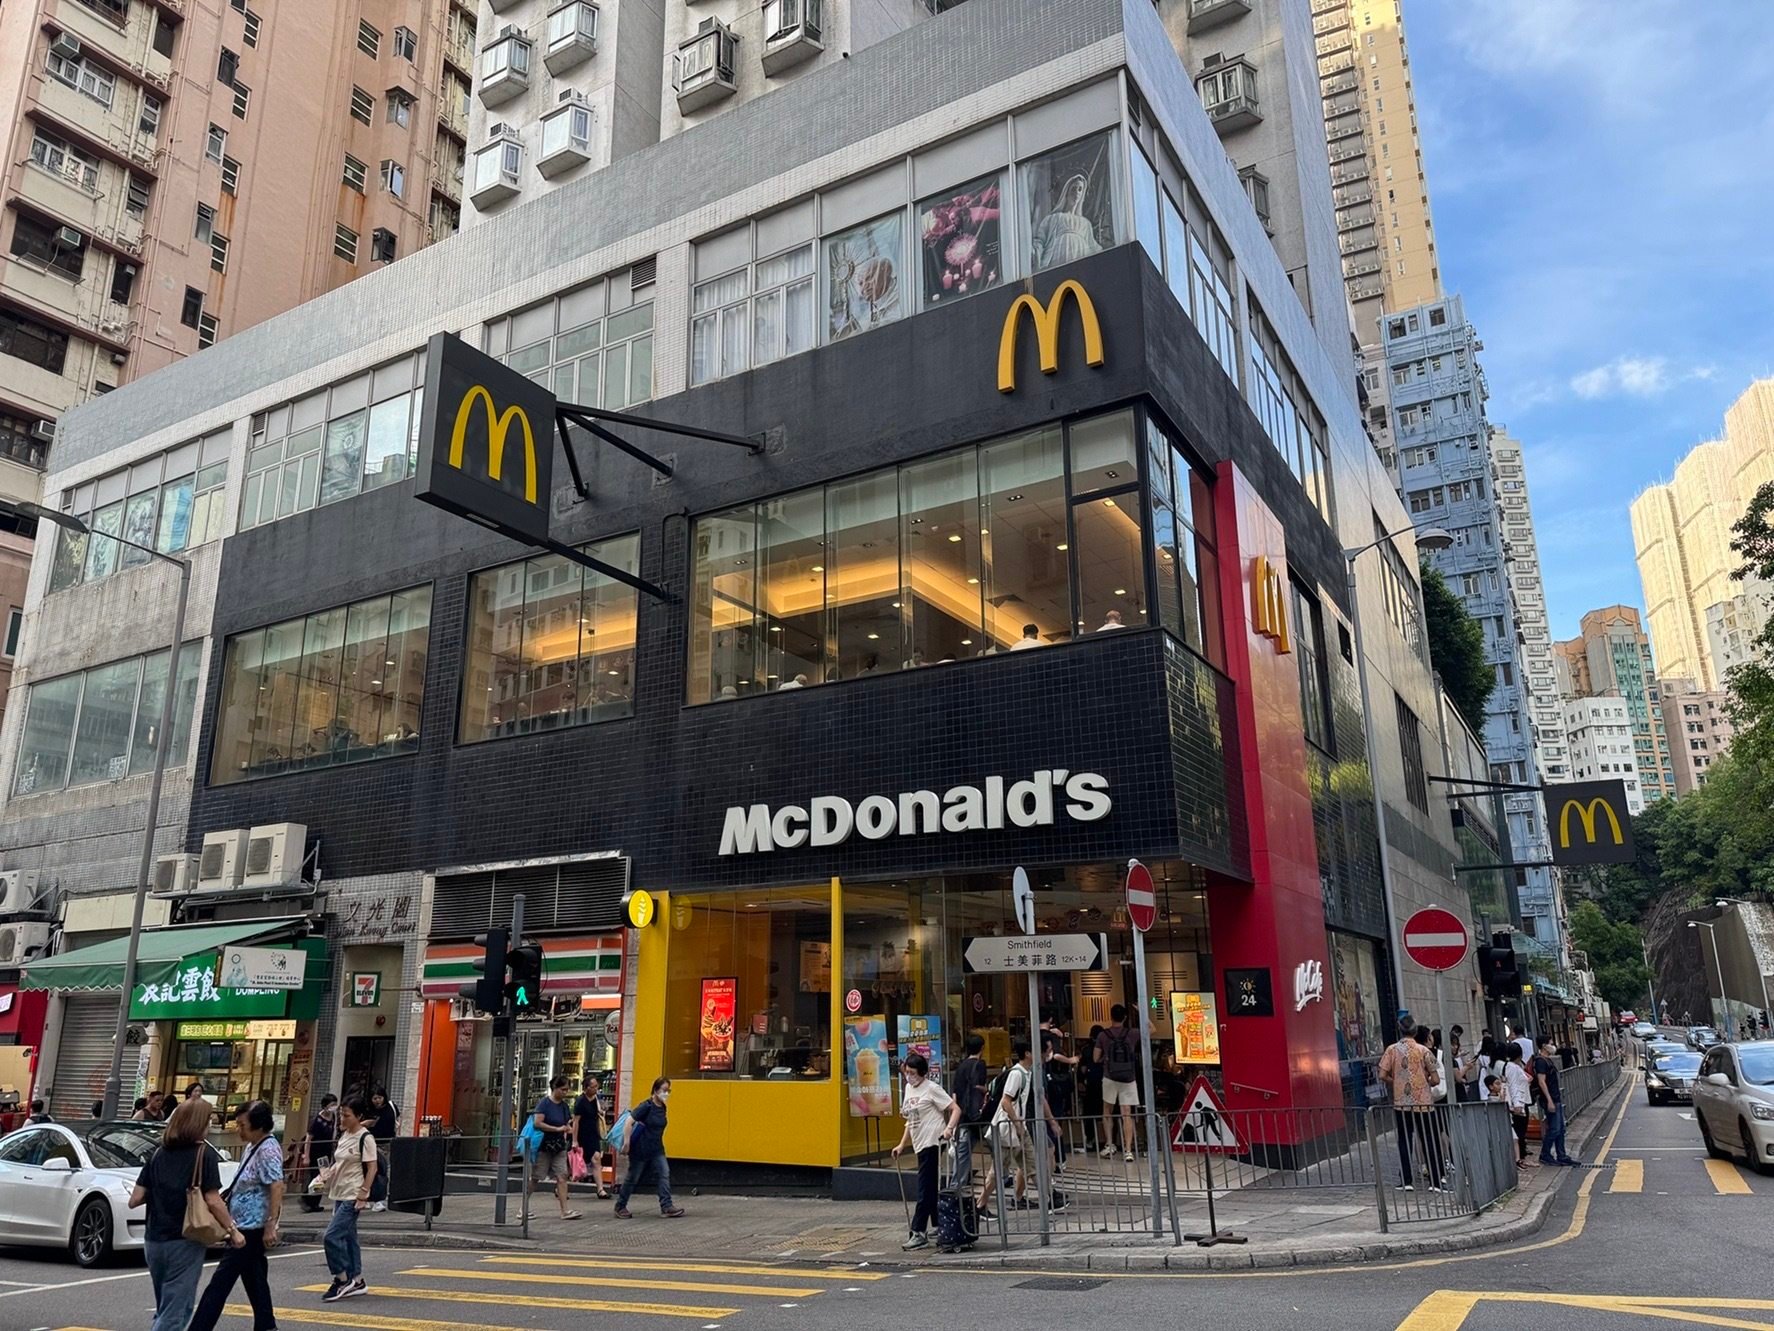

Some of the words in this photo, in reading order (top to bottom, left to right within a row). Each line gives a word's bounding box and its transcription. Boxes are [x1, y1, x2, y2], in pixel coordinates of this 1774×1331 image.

[719, 769, 1113, 856] McDonald's
[1007, 940, 1052, 950] Smithfield
[1003, 953, 1057, 967] 士美菲路
[1241, 994, 1257, 1006] 24
